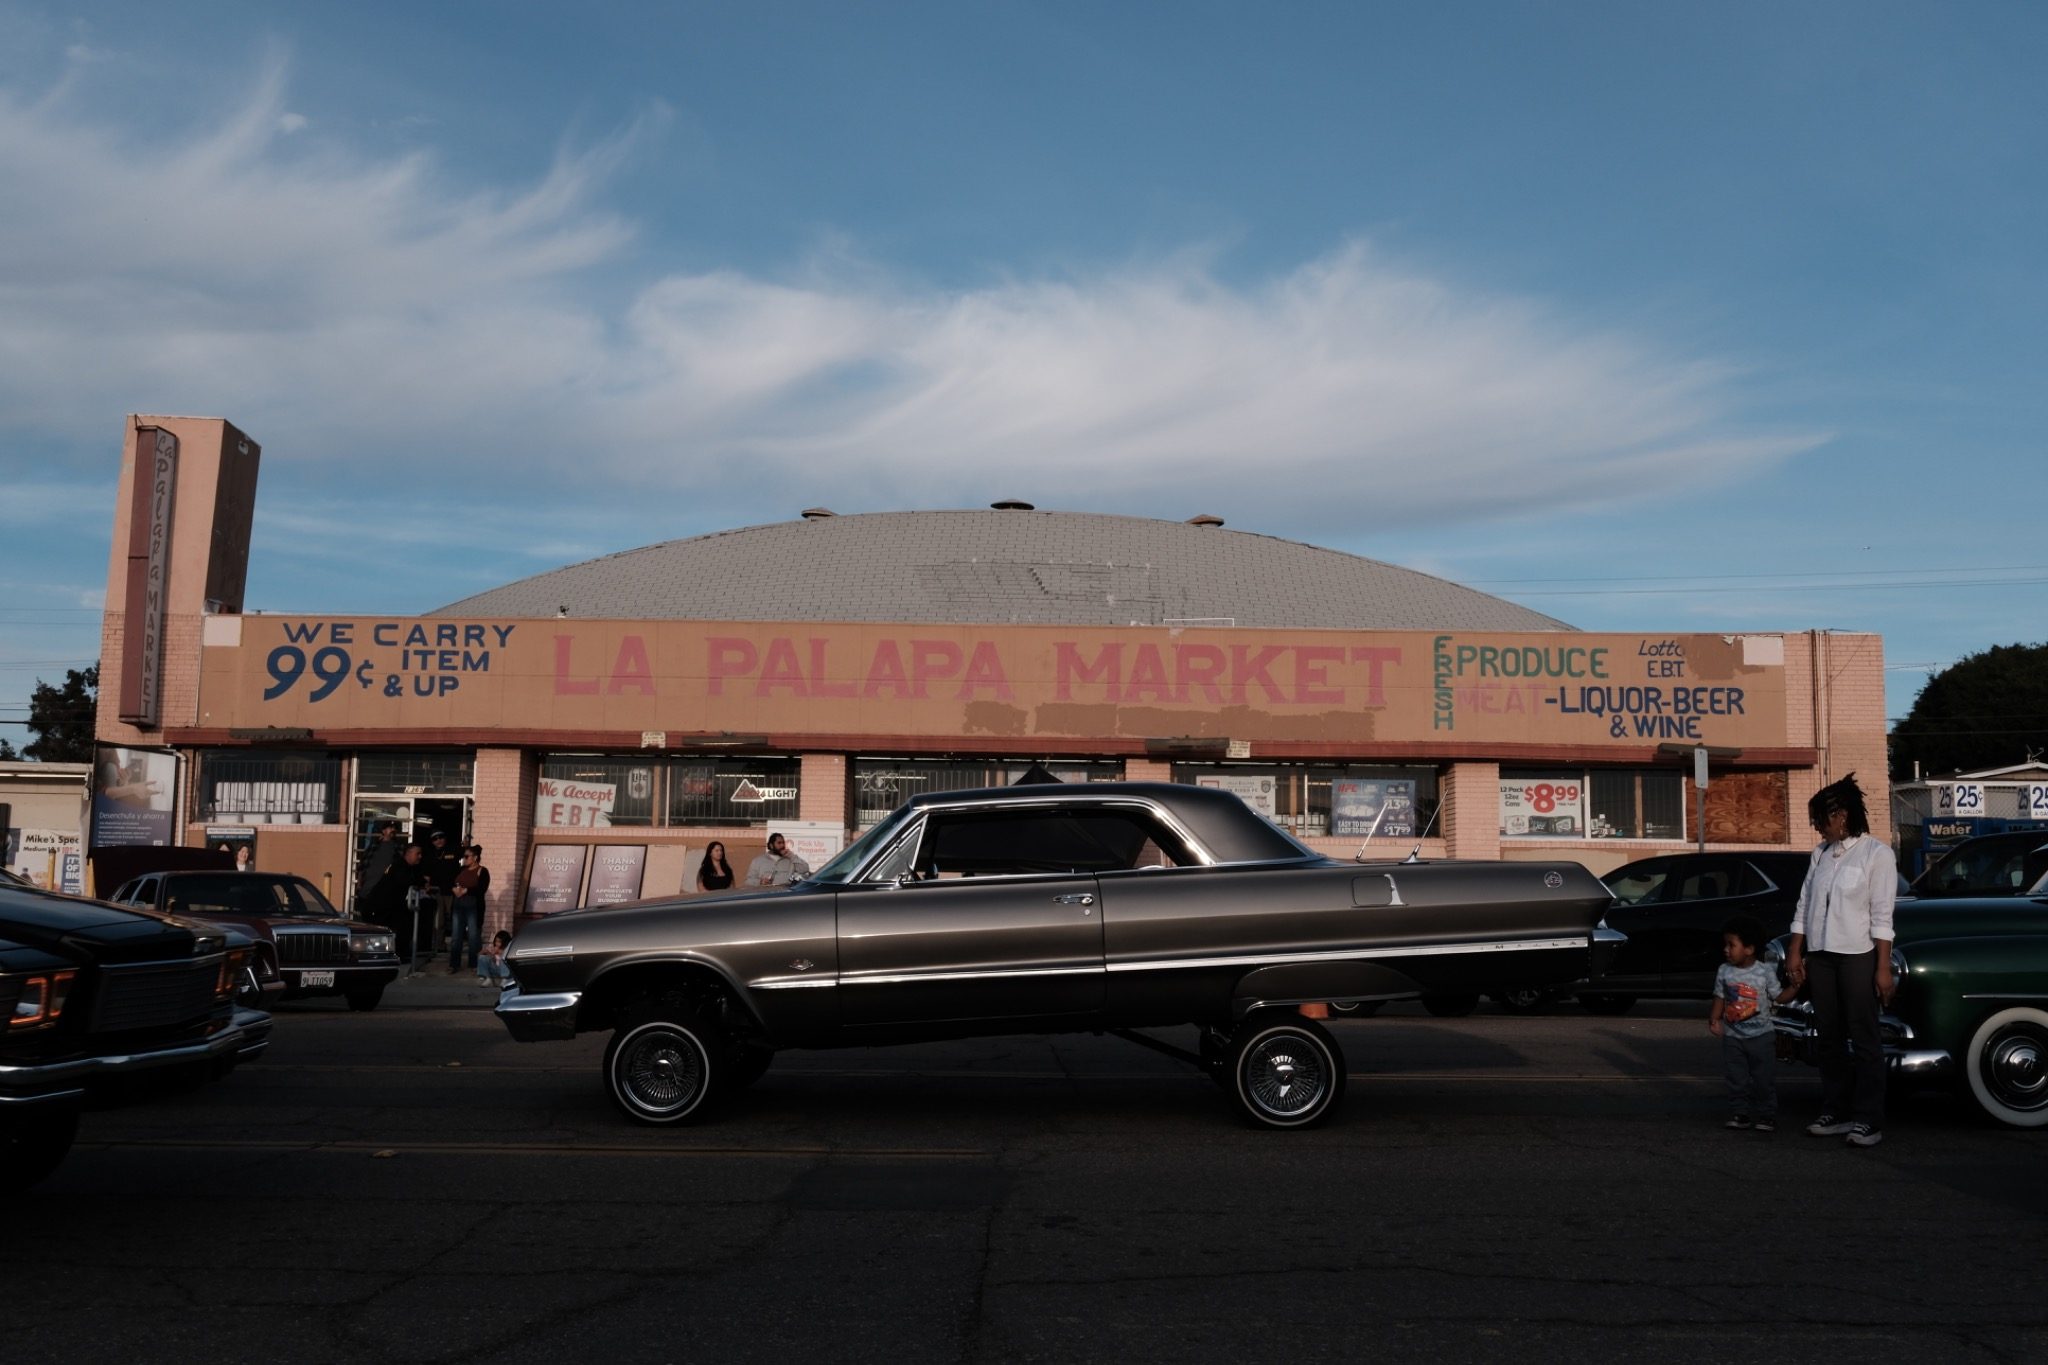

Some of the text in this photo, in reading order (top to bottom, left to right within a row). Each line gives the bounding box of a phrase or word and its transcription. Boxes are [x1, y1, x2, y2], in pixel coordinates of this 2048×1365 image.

[155, 436, 173, 459] La
[283, 623, 515, 648] WE CARRY
[141, 590, 159, 718] MARKET
[402, 650, 489, 671] ITEM
[1457, 645, 1608, 678] PRODUCE
[554, 635, 1401, 706] LA PALAPA MARKET
[383, 674, 459, 697] & UP
[1434, 636, 1453, 730] FRESH
[1610, 715, 1702, 738] & WINE
[539, 781, 614, 805] We Accept
[767, 790, 796, 798] LIGHT
[1956, 785, 1984, 808] 25¢
[26, 835, 55, 844] Mike's
[1929, 823, 1972, 836] Water
[543, 857, 577, 865] THANK
[548, 864, 568, 872] YOU
[602, 857, 635, 865] THANK
[608, 864, 628, 872] YOU
